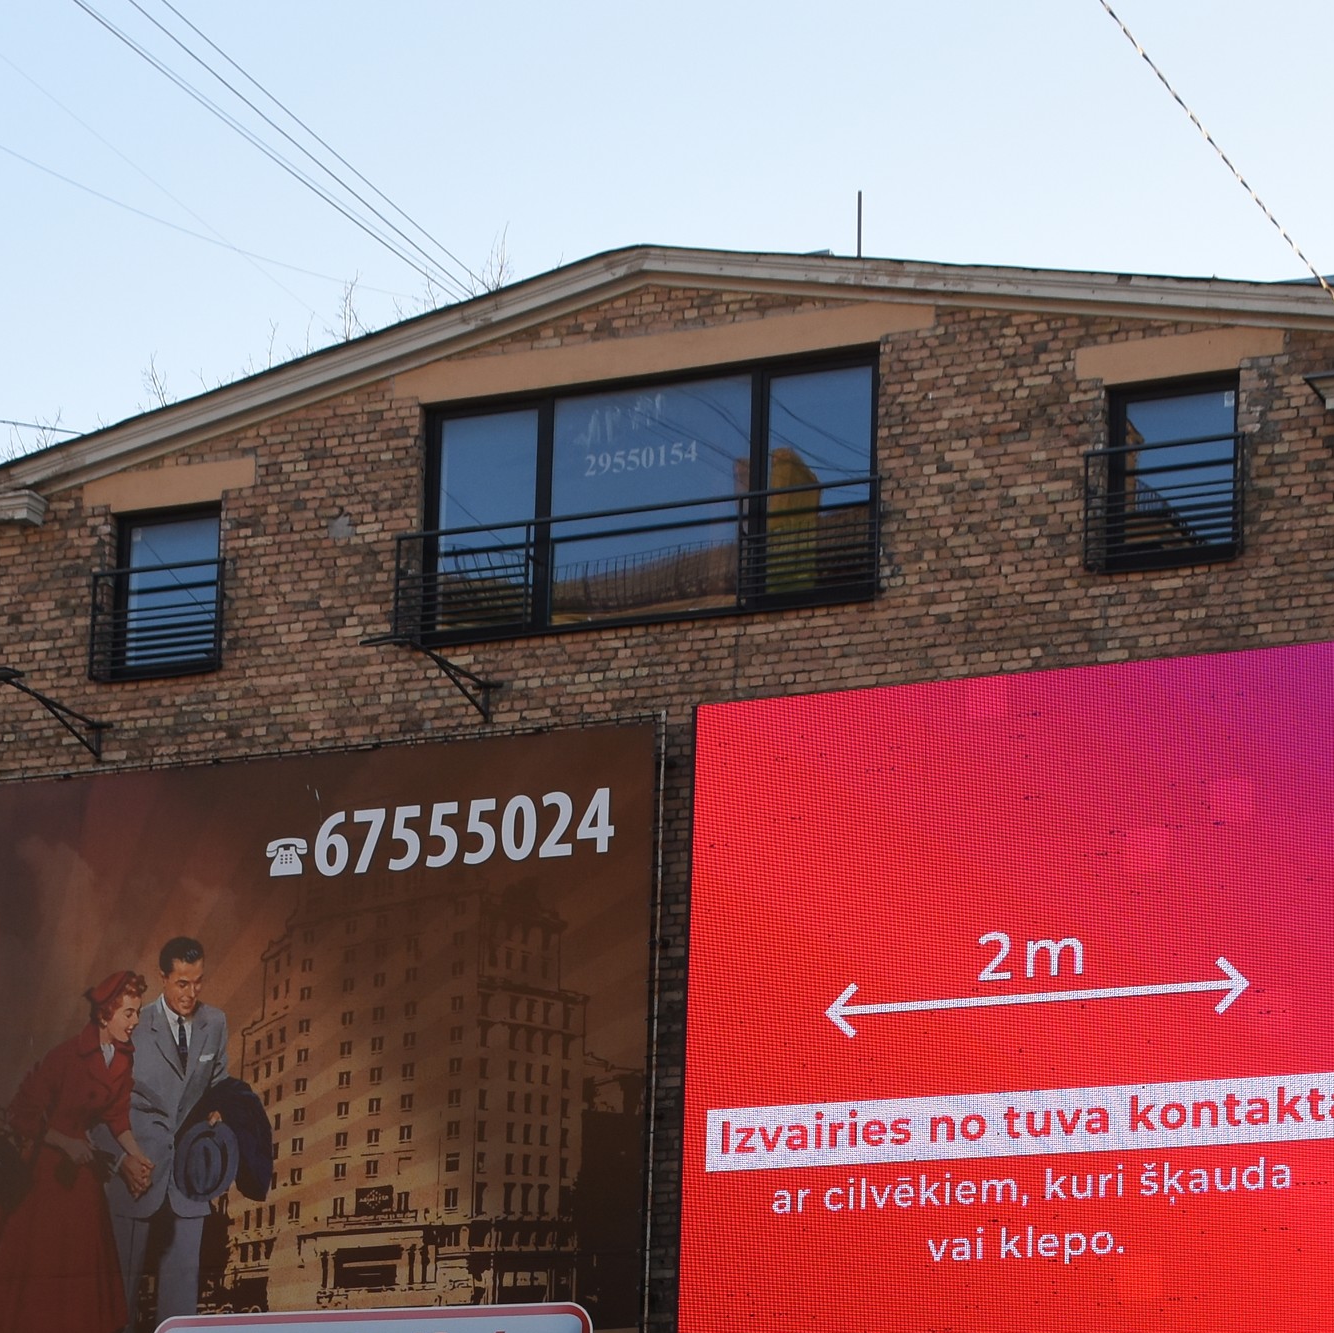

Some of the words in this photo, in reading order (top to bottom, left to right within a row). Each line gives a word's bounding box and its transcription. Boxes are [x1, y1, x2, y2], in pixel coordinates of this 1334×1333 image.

[584, 440, 698, 477] 29550154
[315, 788, 614, 876] 67555024
[720, 1110, 911, 1155] Izvairies
[930, 1115, 986, 1142] no
[1004, 1105, 1109, 1139] tuva
[772, 1188, 809, 1214] ar
[824, 1171, 1028, 1212] cilvēkiem,
[1044, 1164, 1124, 1202] kuri
[1140, 1157, 1292, 1206] šķauda
[928, 1227, 984, 1262] vai
[1001, 1223, 1124, 1264] klepo.
